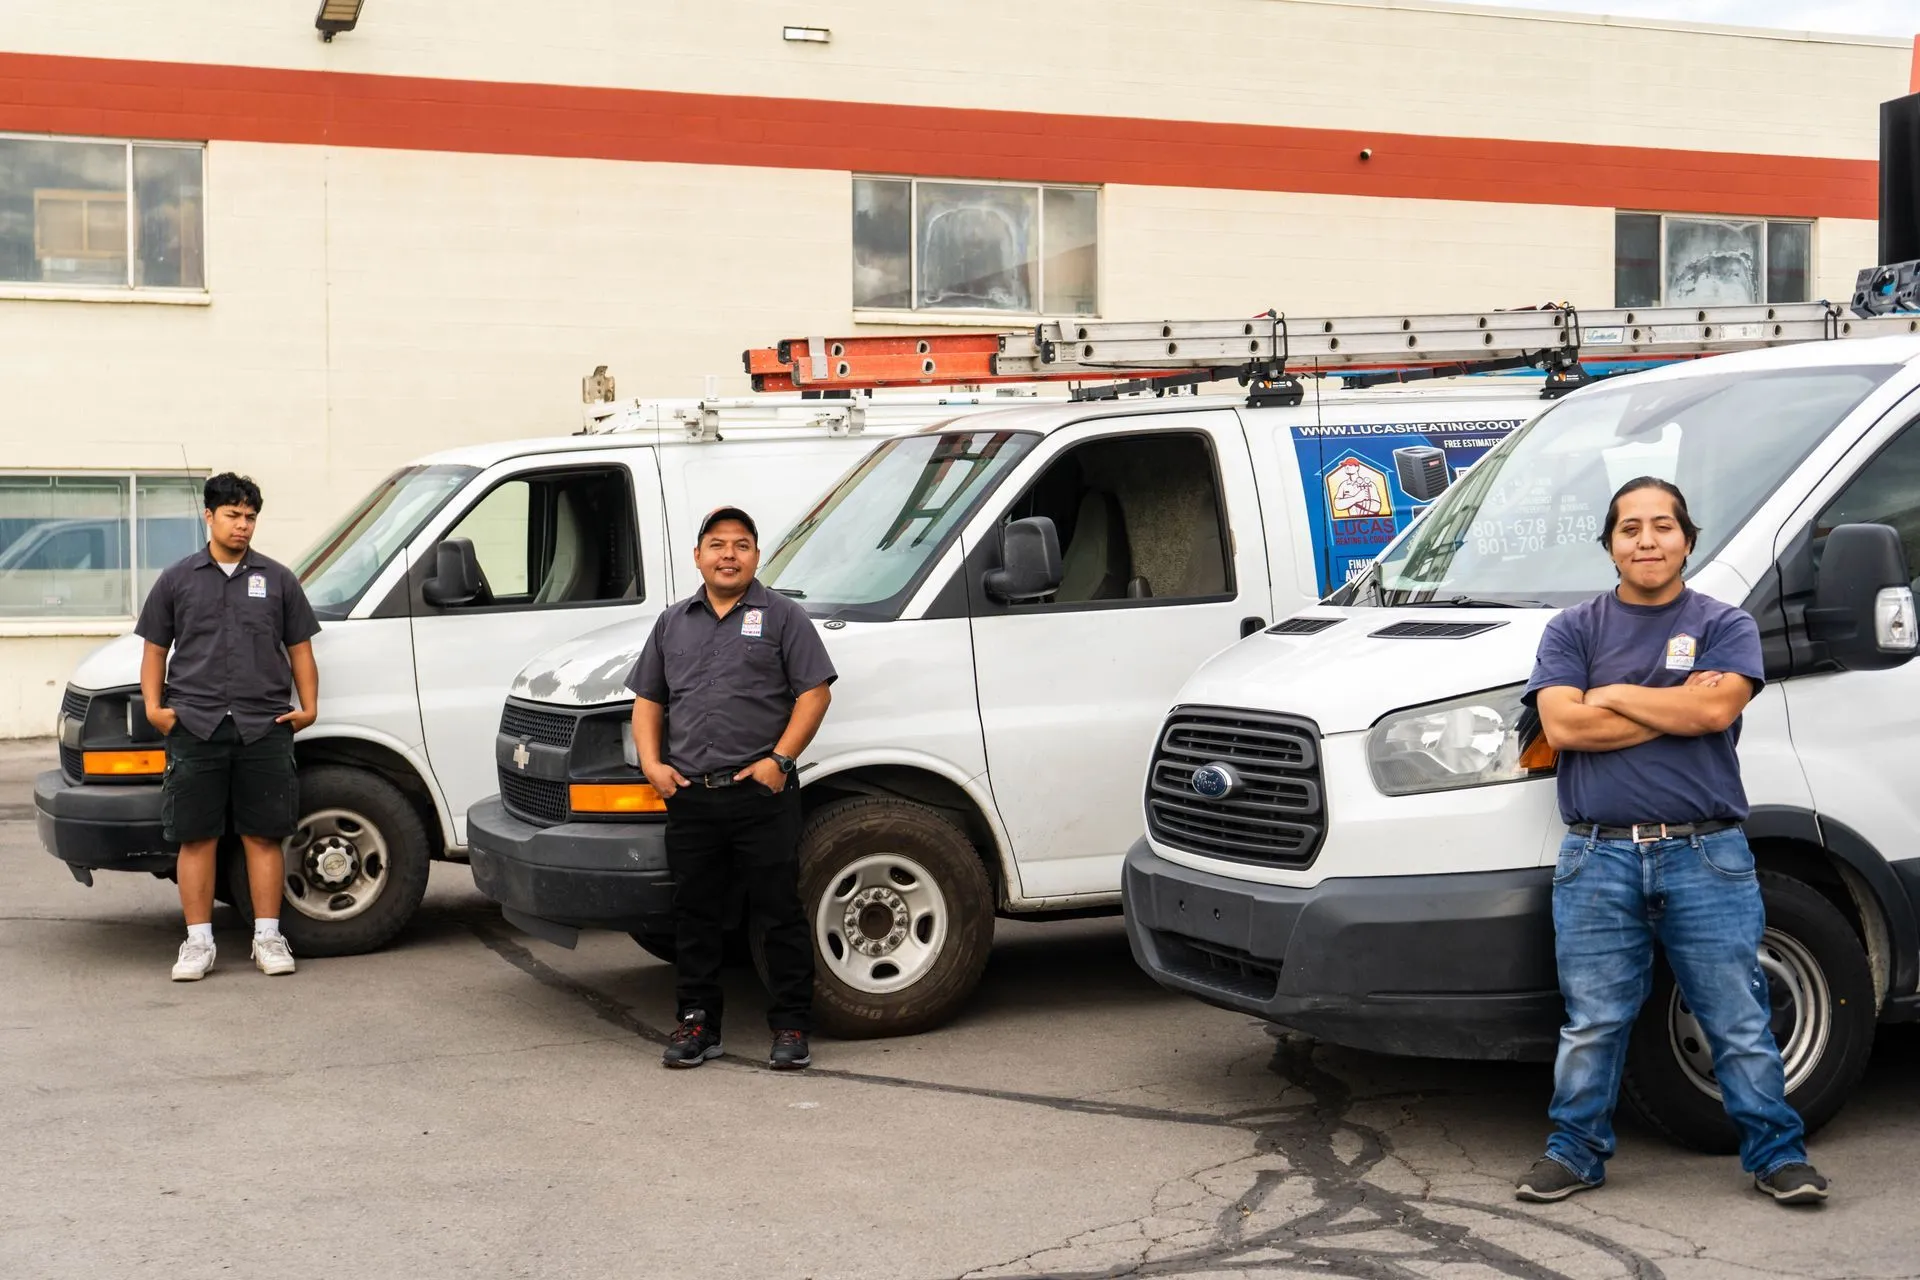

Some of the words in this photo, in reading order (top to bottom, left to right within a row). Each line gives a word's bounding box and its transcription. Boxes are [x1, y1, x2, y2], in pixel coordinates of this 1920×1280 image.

[1444, 439, 1462, 448] FREE
[1333, 518, 1395, 536] LUCAS
[1336, 536, 1361, 546] HEATING
